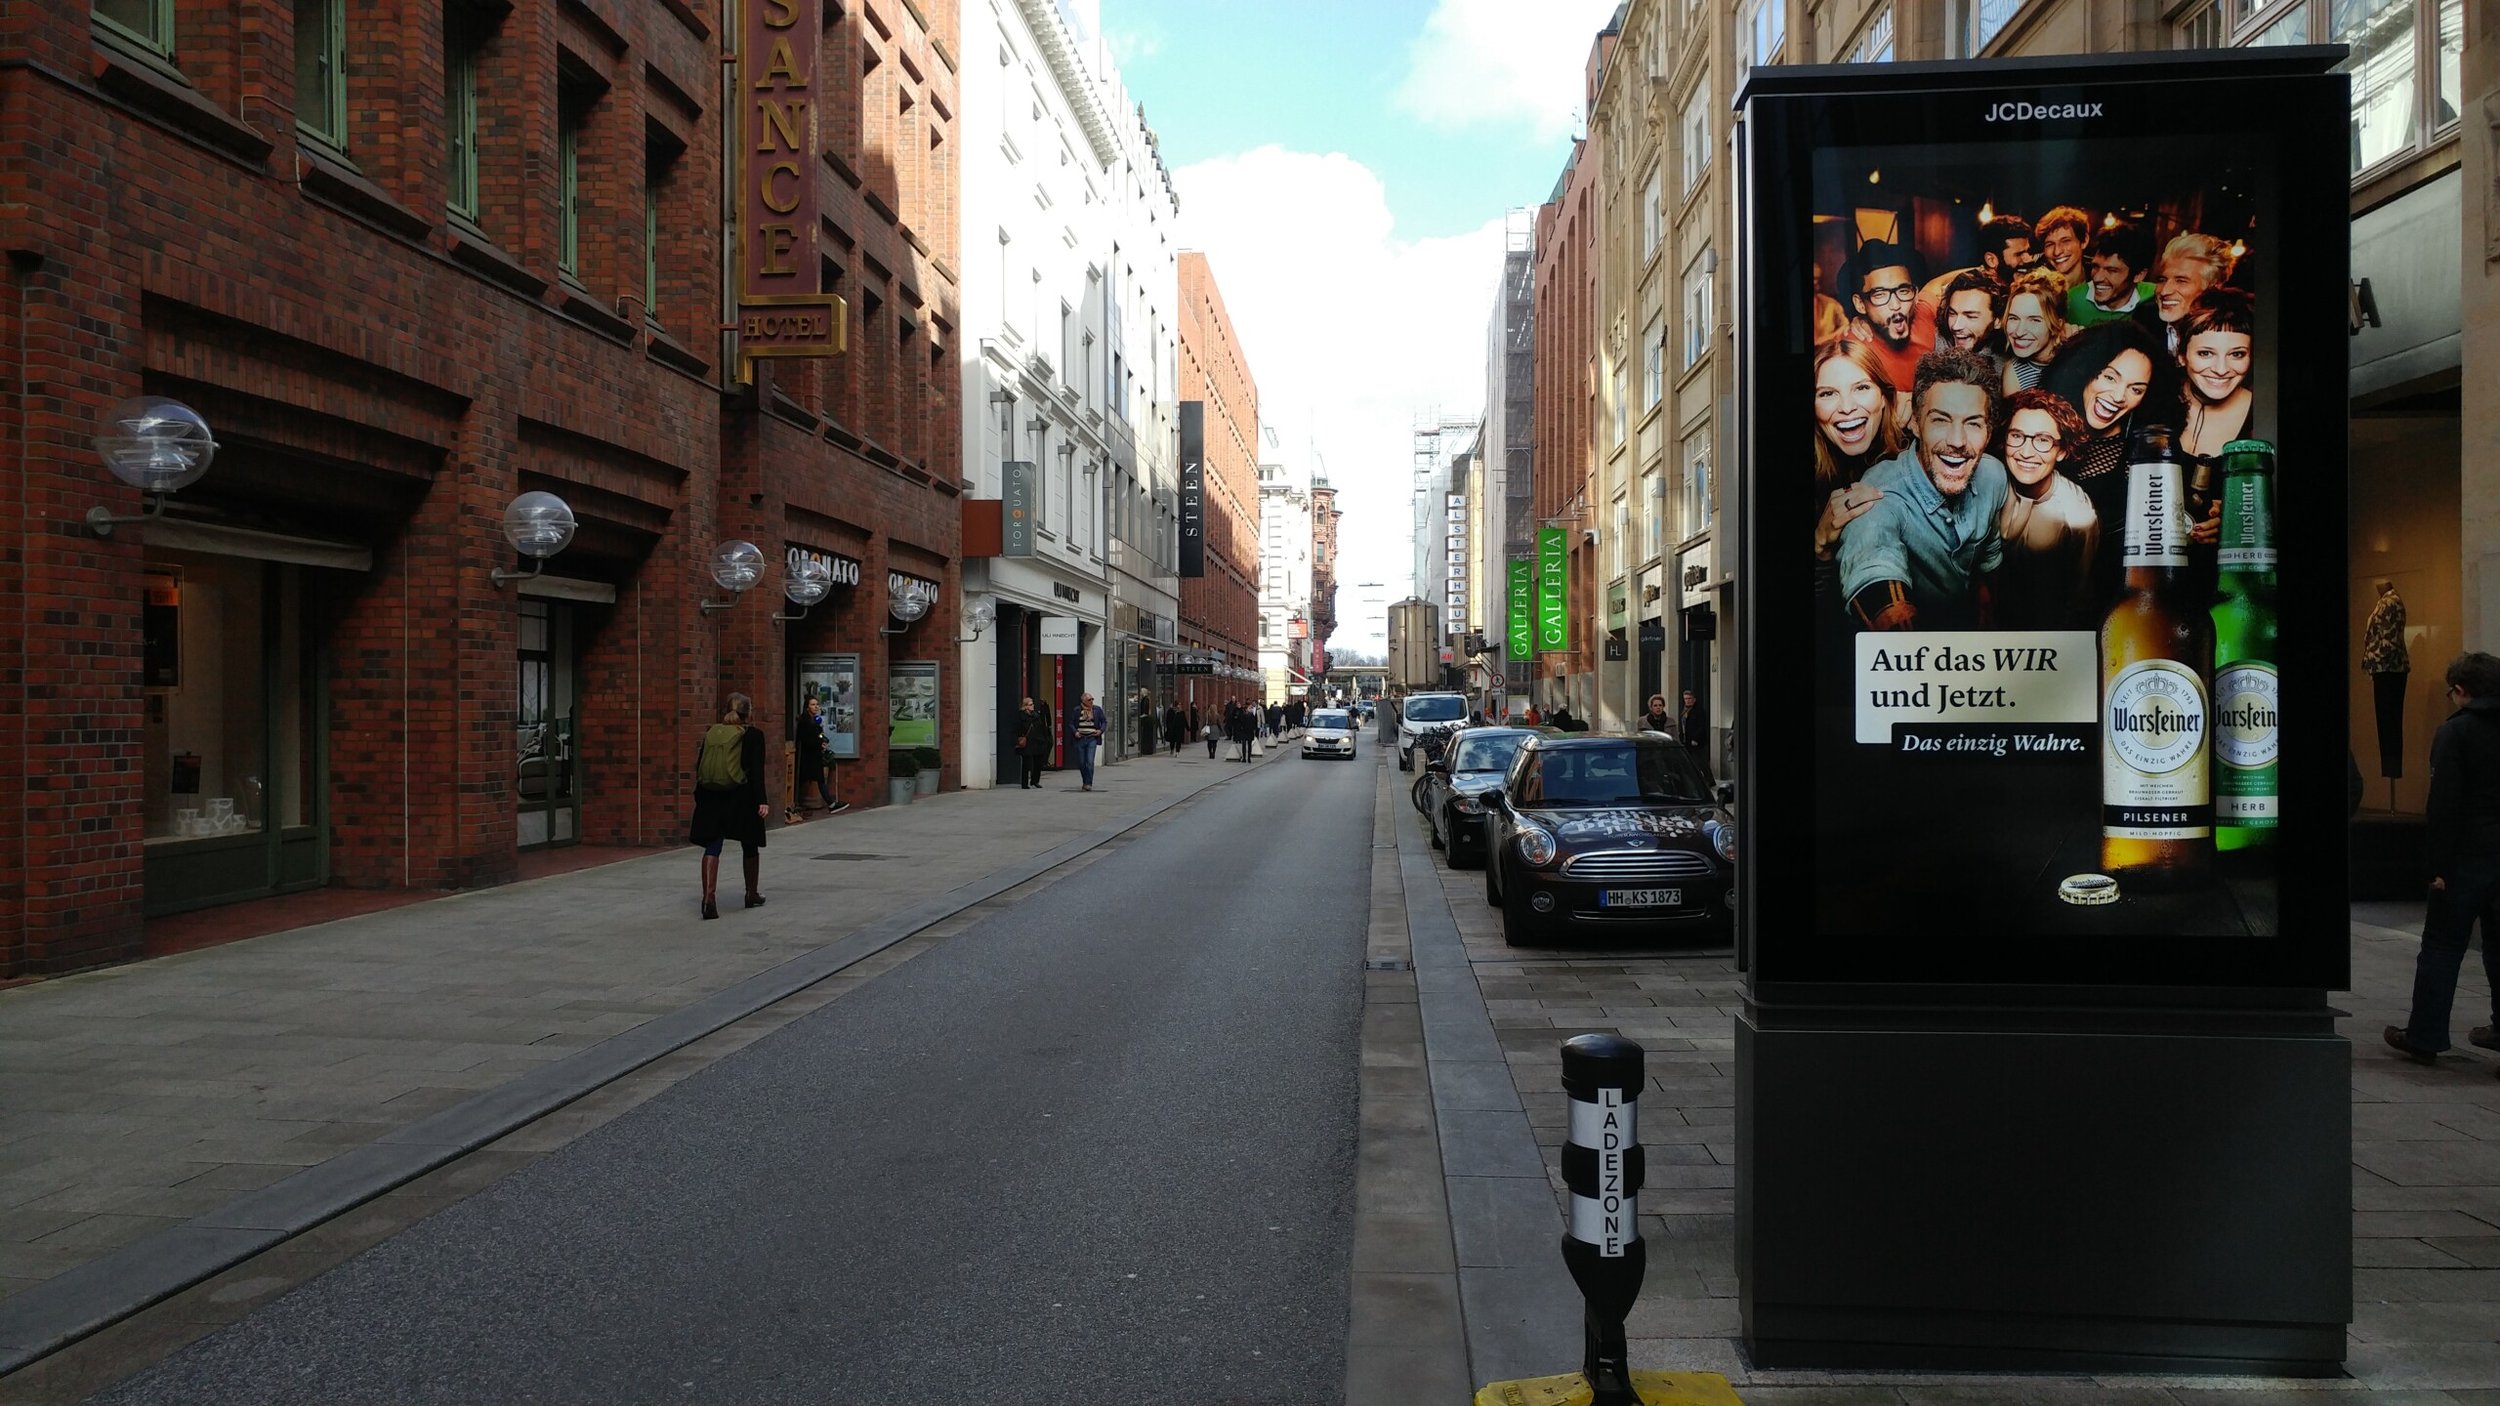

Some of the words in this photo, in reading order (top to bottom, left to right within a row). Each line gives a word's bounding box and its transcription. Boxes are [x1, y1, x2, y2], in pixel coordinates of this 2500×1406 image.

[1985, 102, 2103, 122] JCDecaux
[743, 314, 827, 339] HOTEL
[1012, 468, 1024, 548] TORQUATO
[1186, 462, 1198, 537] STEEN
[2235, 481, 2255, 545] Warsteiner
[2144, 474, 2164, 557] Warsteiner
[1453, 497, 1462, 632] ALSTERHAUS
[1545, 535, 1562, 644] GALLERIA
[1514, 566, 1528, 655] GALLERIA
[1870, 646, 1929, 671] Auf
[1934, 646, 1985, 671] das
[1993, 648, 2057, 671] WIR
[1870, 683, 1929, 707] und
[1937, 684, 2016, 714] Jetzt.
[2120, 689, 2133, 704] SEIT
[2181, 689, 2193, 705] 1753
[2114, 705, 2200, 736] Warsteiner
[2215, 702, 2278, 731] arstein
[1902, 734, 1941, 751] Das
[1946, 733, 2008, 757] einzig
[2013, 733, 2085, 751] Wahre.
[2121, 740, 2133, 755] DAS
[2135, 753, 2166, 765] EINZIG
[2169, 740, 2193, 761] WAHRE
[2123, 812, 2188, 822] PILSENER
[2231, 803, 2265, 811] HERB
[1608, 892, 1623, 904] HH
[1632, 891, 1648, 904] KS
[1651, 890, 1680, 903] 1873
[1603, 1090, 1620, 1255] LADEZONE
